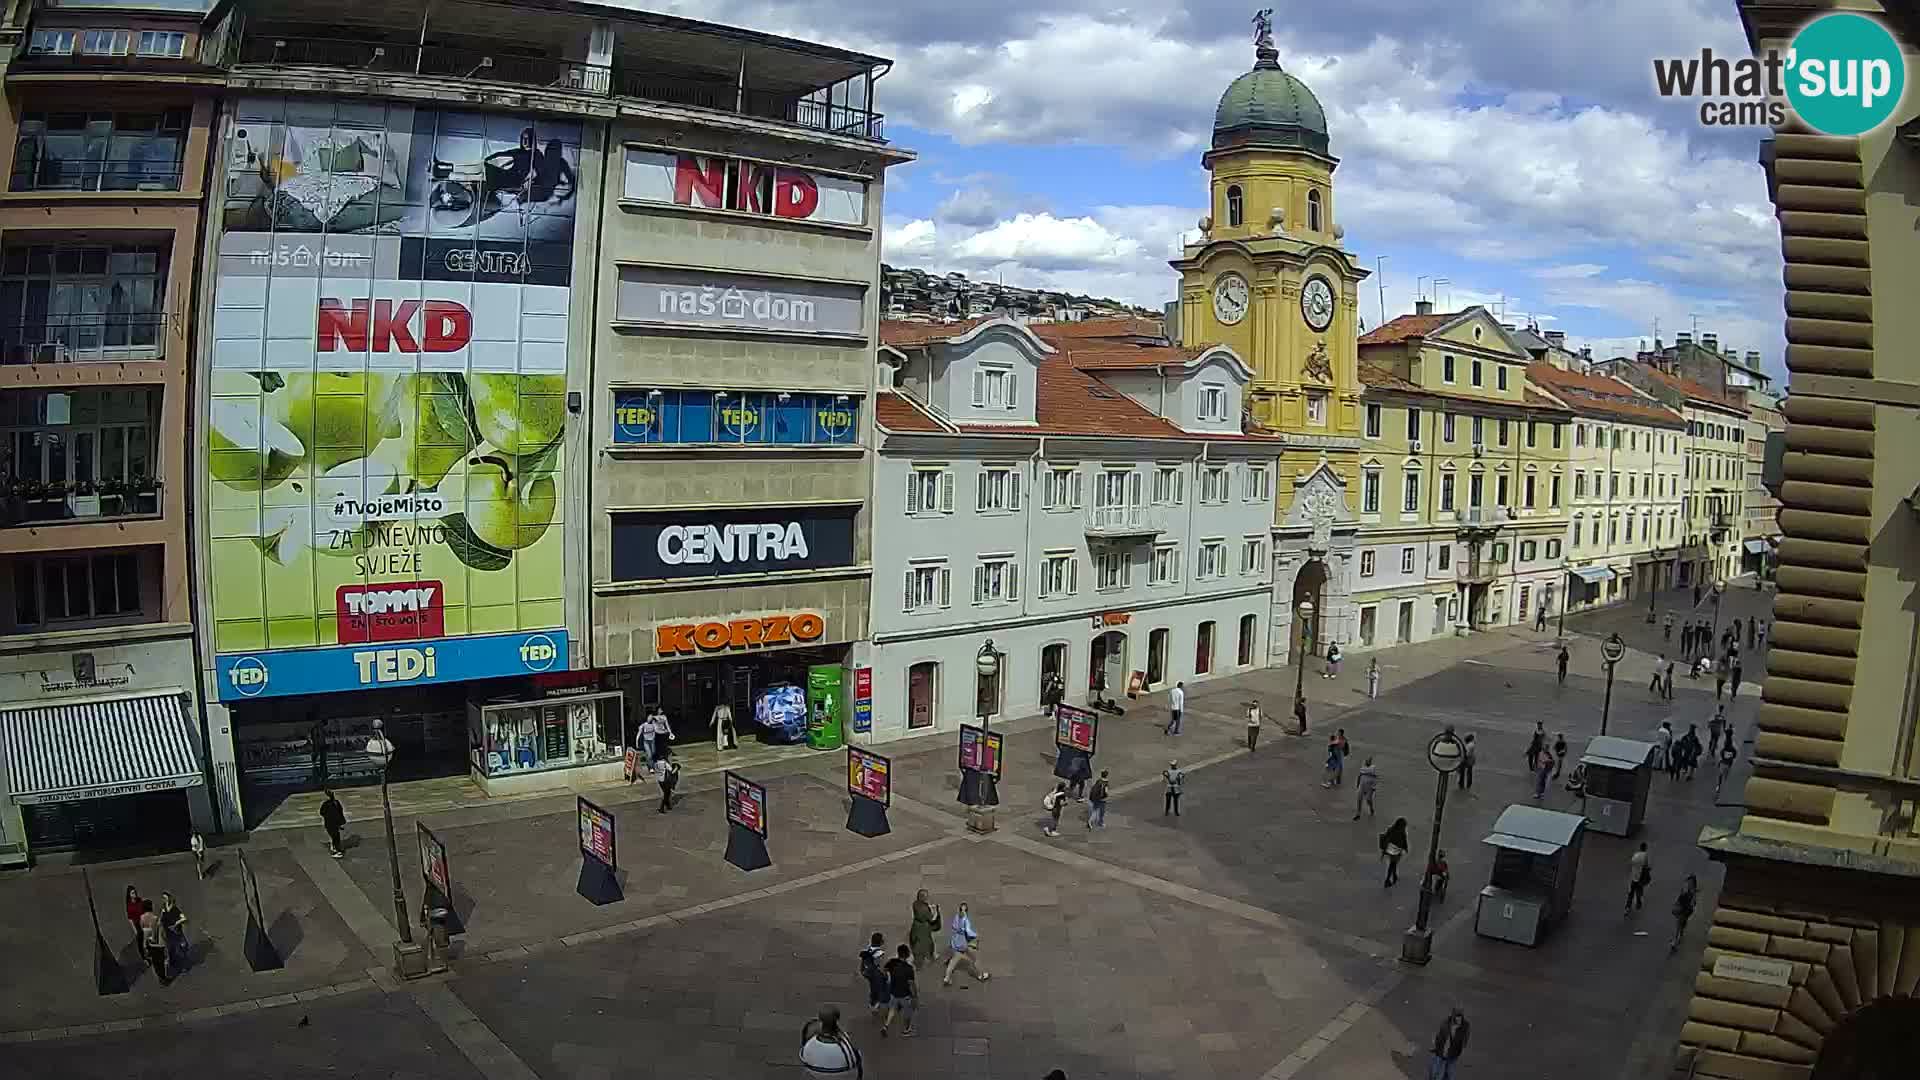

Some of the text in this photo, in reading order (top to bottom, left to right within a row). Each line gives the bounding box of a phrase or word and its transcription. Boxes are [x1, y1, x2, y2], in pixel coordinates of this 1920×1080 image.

[674, 155, 819, 219] NKD
[315, 246, 361, 268] dom
[445, 248, 531, 275] CENTRA
[659, 284, 816, 322] naš dom
[317, 297, 473, 353] NKD
[616, 407, 655, 426] TEDi
[721, 407, 758, 426] TEDi
[818, 409, 852, 427] TEDi
[334, 497, 443, 517] #TvojeMisto
[329, 524, 447, 550] ZA DNEVNO
[657, 521, 809, 565] CENTRA
[355, 548, 423, 576] SVJEŽE
[344, 587, 435, 615] TOMMY
[656, 612, 824, 656] KORZO
[353, 647, 438, 684] TEDi
[519, 642, 557, 663] TEDi
[229, 664, 269, 687] TEDi
